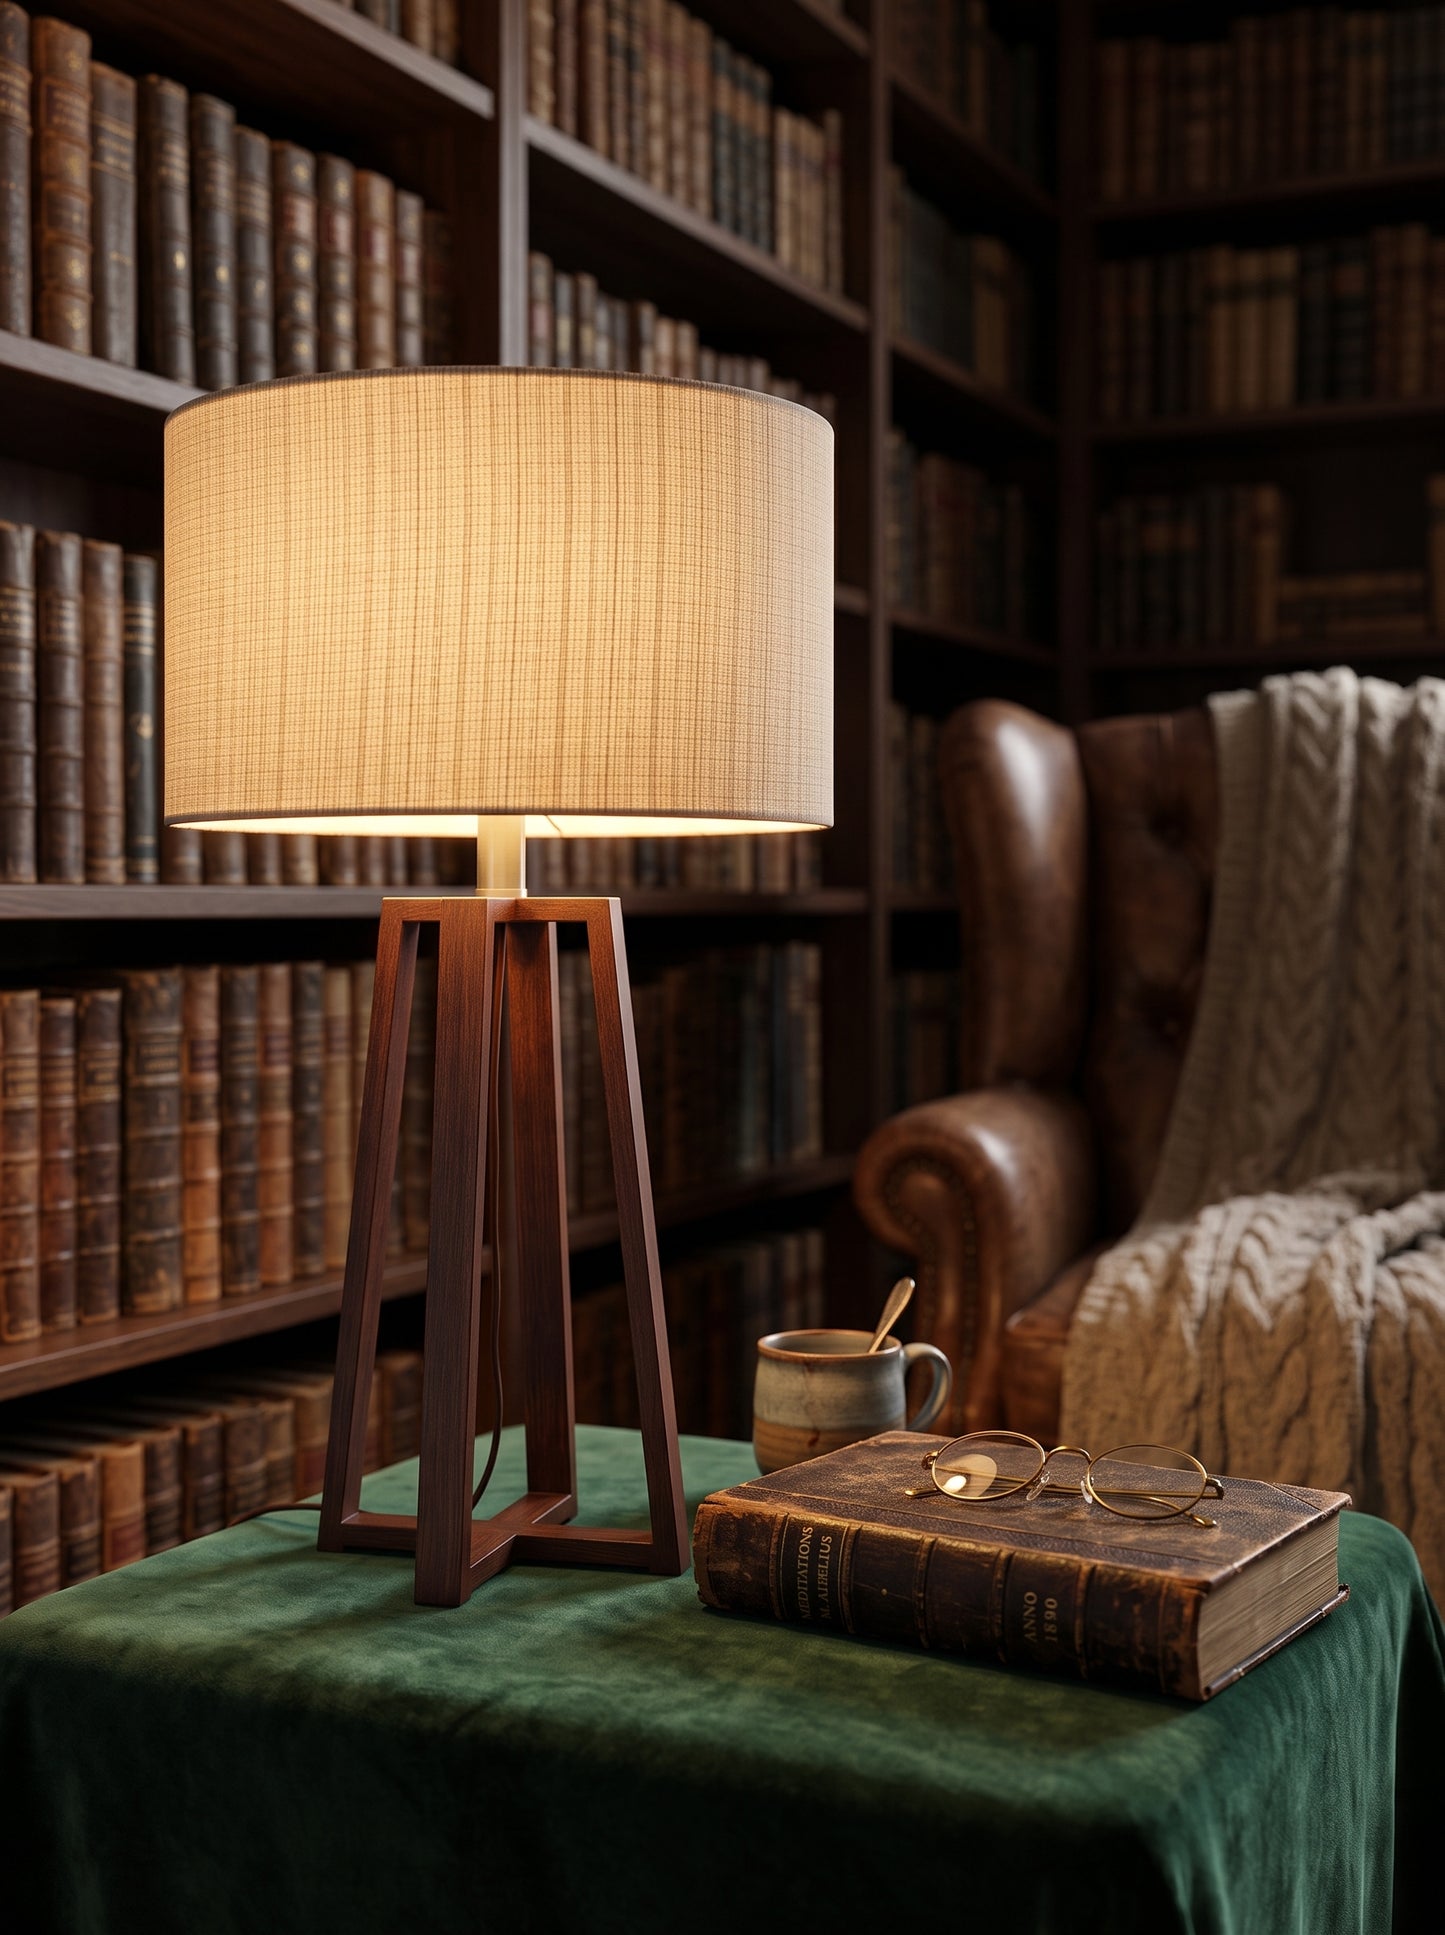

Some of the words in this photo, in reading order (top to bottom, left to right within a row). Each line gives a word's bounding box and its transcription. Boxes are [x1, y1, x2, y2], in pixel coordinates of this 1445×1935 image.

[797, 1526, 813, 1619] MEDITATIONS
[1023, 1591, 1038, 1642] ANNO
[1043, 1597, 1059, 1642] 1890
